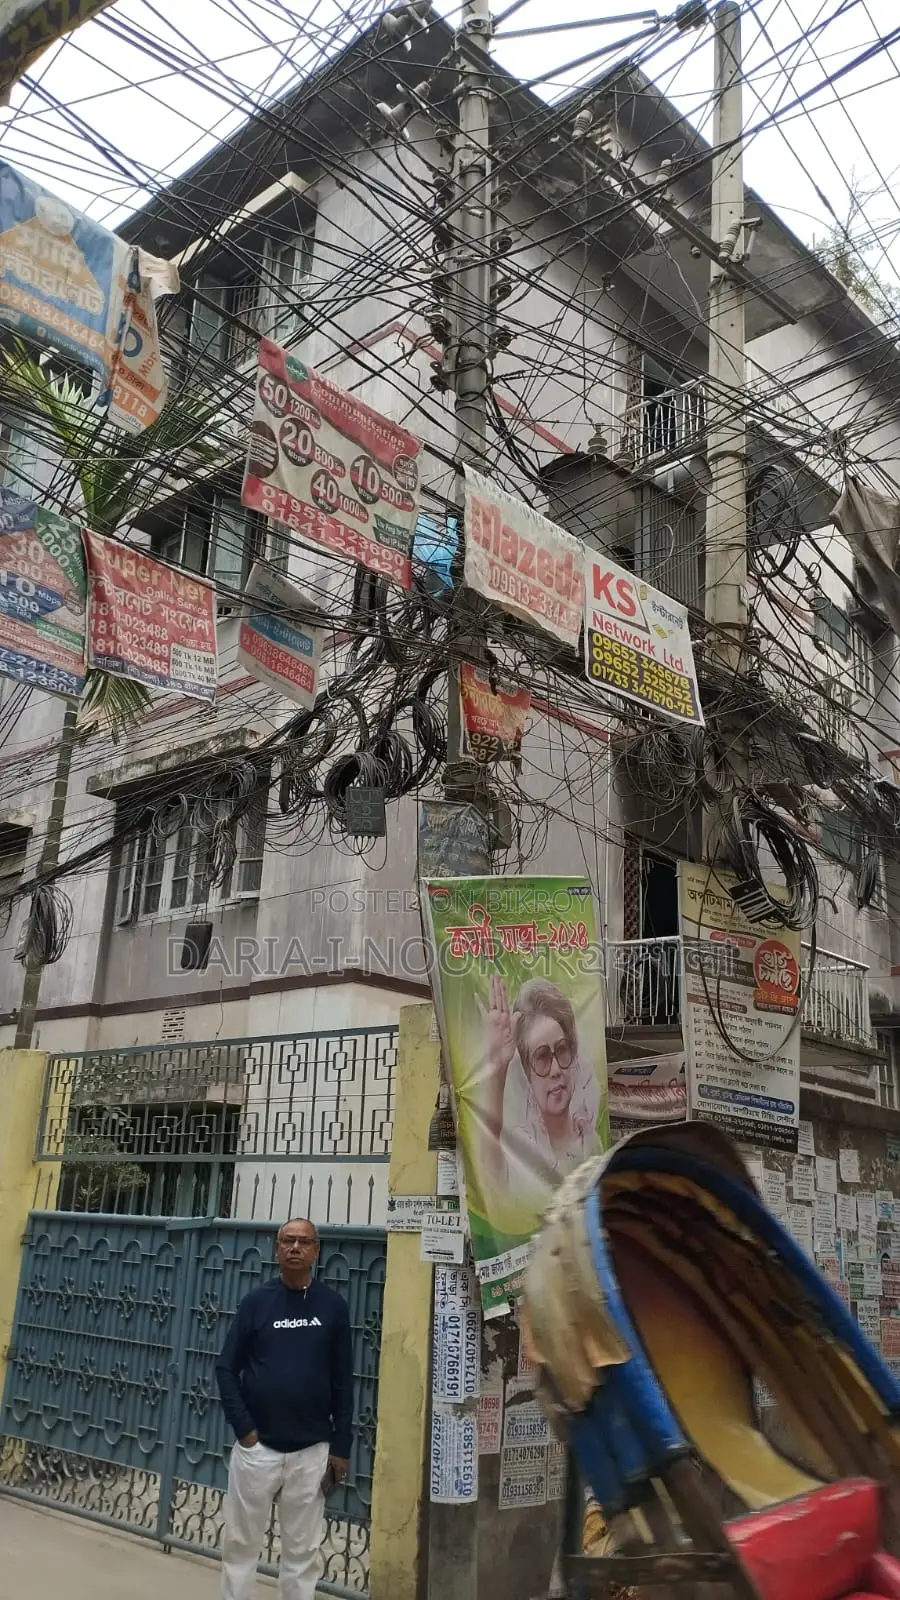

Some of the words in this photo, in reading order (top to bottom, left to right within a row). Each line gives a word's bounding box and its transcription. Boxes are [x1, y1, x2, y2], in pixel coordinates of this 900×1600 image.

[262, 375, 288, 408] 50
[290, 398, 311, 421] 1200
[280, 421, 312, 455] 20
[314, 446, 335, 470] 800
[313, 473, 338, 504] 40
[340, 495, 361, 516] 1000
[354, 459, 380, 494] 10
[381, 484, 402, 506] 500
[262, 485, 405, 567] 01958-123600
[90, 533, 162, 586] Super
[592, 563, 636, 617] KS
[592, 610, 656, 657] Network
[663, 648, 689, 675] Ltd.
[592, 632, 638, 664] 09652
[640, 655, 690, 690] 345678
[592, 648, 639, 677] 09652
[643, 671, 693, 703] 525252
[592, 662, 629, 690] 01733
[632, 679, 695, 717] 347570-75
[426, 1214, 461, 1227] TO-LET
[273, 1318, 308, 1329] adidas
[465, 1311, 477, 1393] 01714076290
